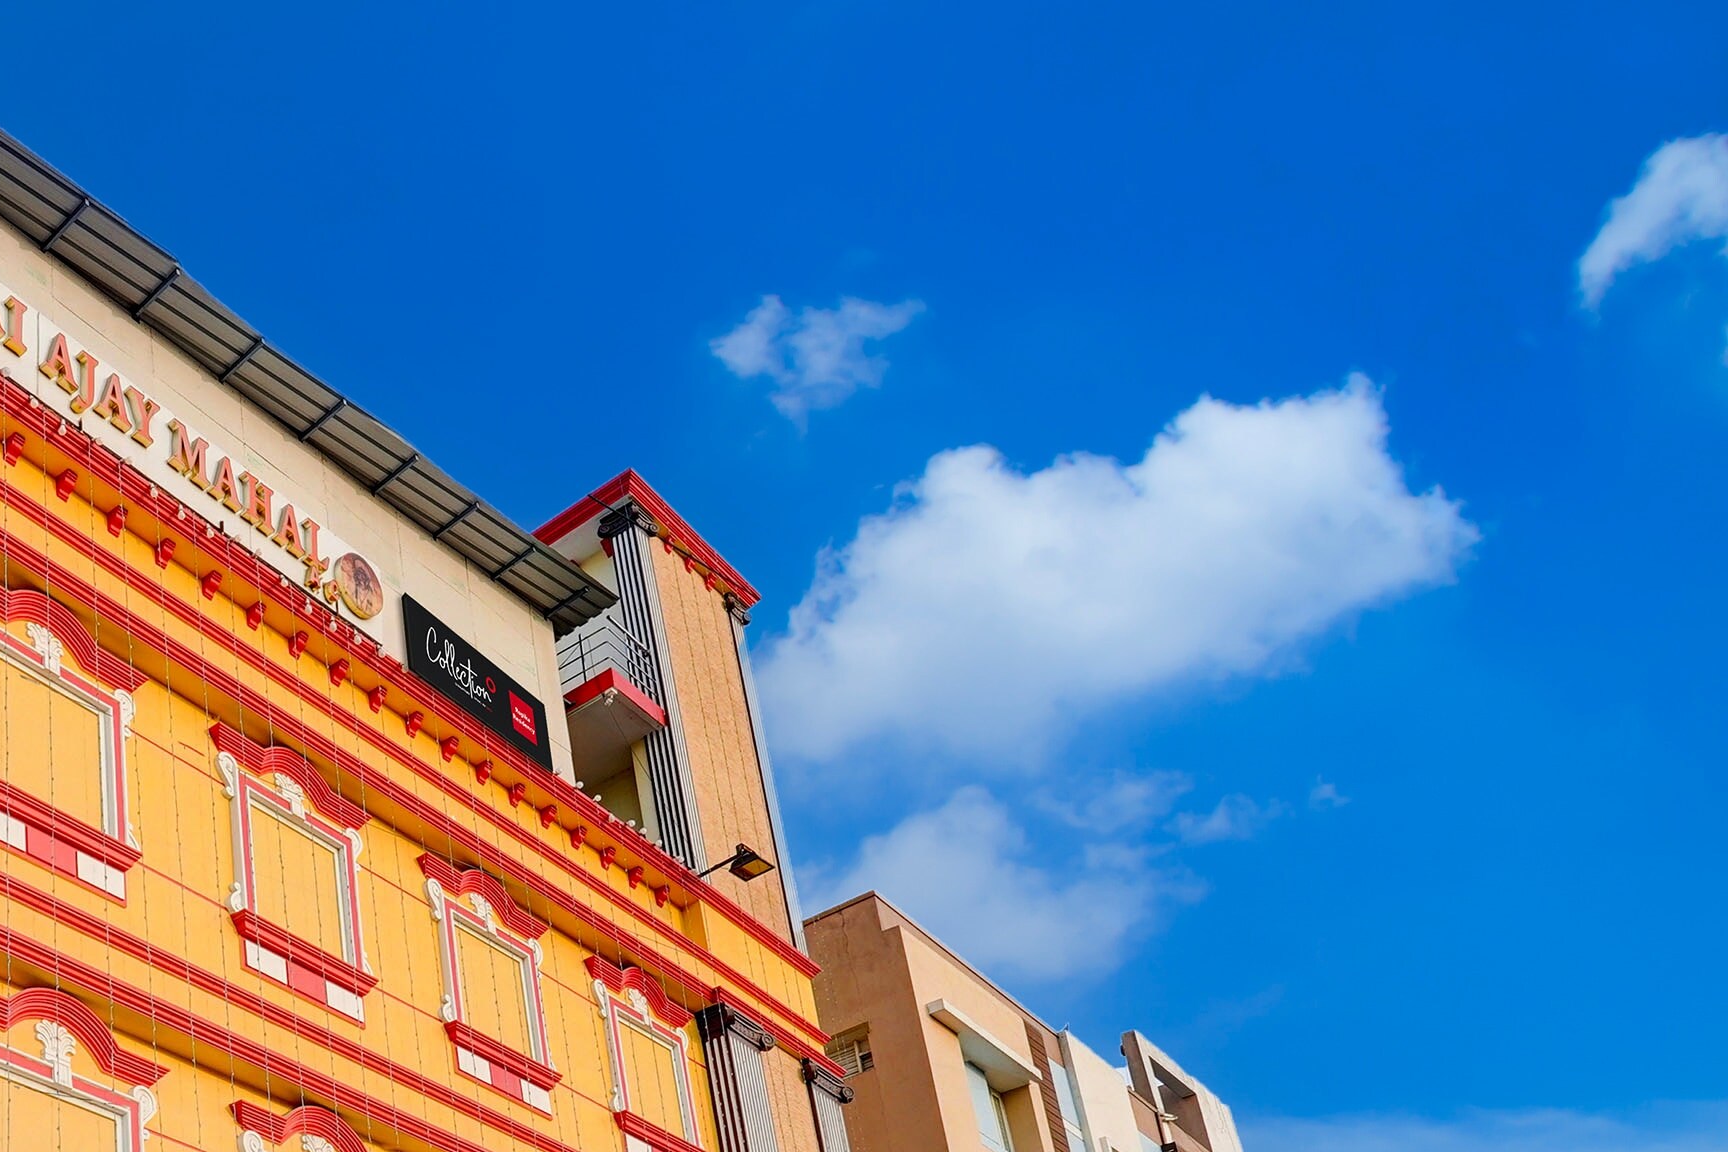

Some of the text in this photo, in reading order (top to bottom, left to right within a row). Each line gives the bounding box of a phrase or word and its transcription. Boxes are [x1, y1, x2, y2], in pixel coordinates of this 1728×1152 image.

[39, 333, 160, 448] AJAY
[167, 418, 330, 573] MAHAL
[426, 627, 492, 702] Collection
